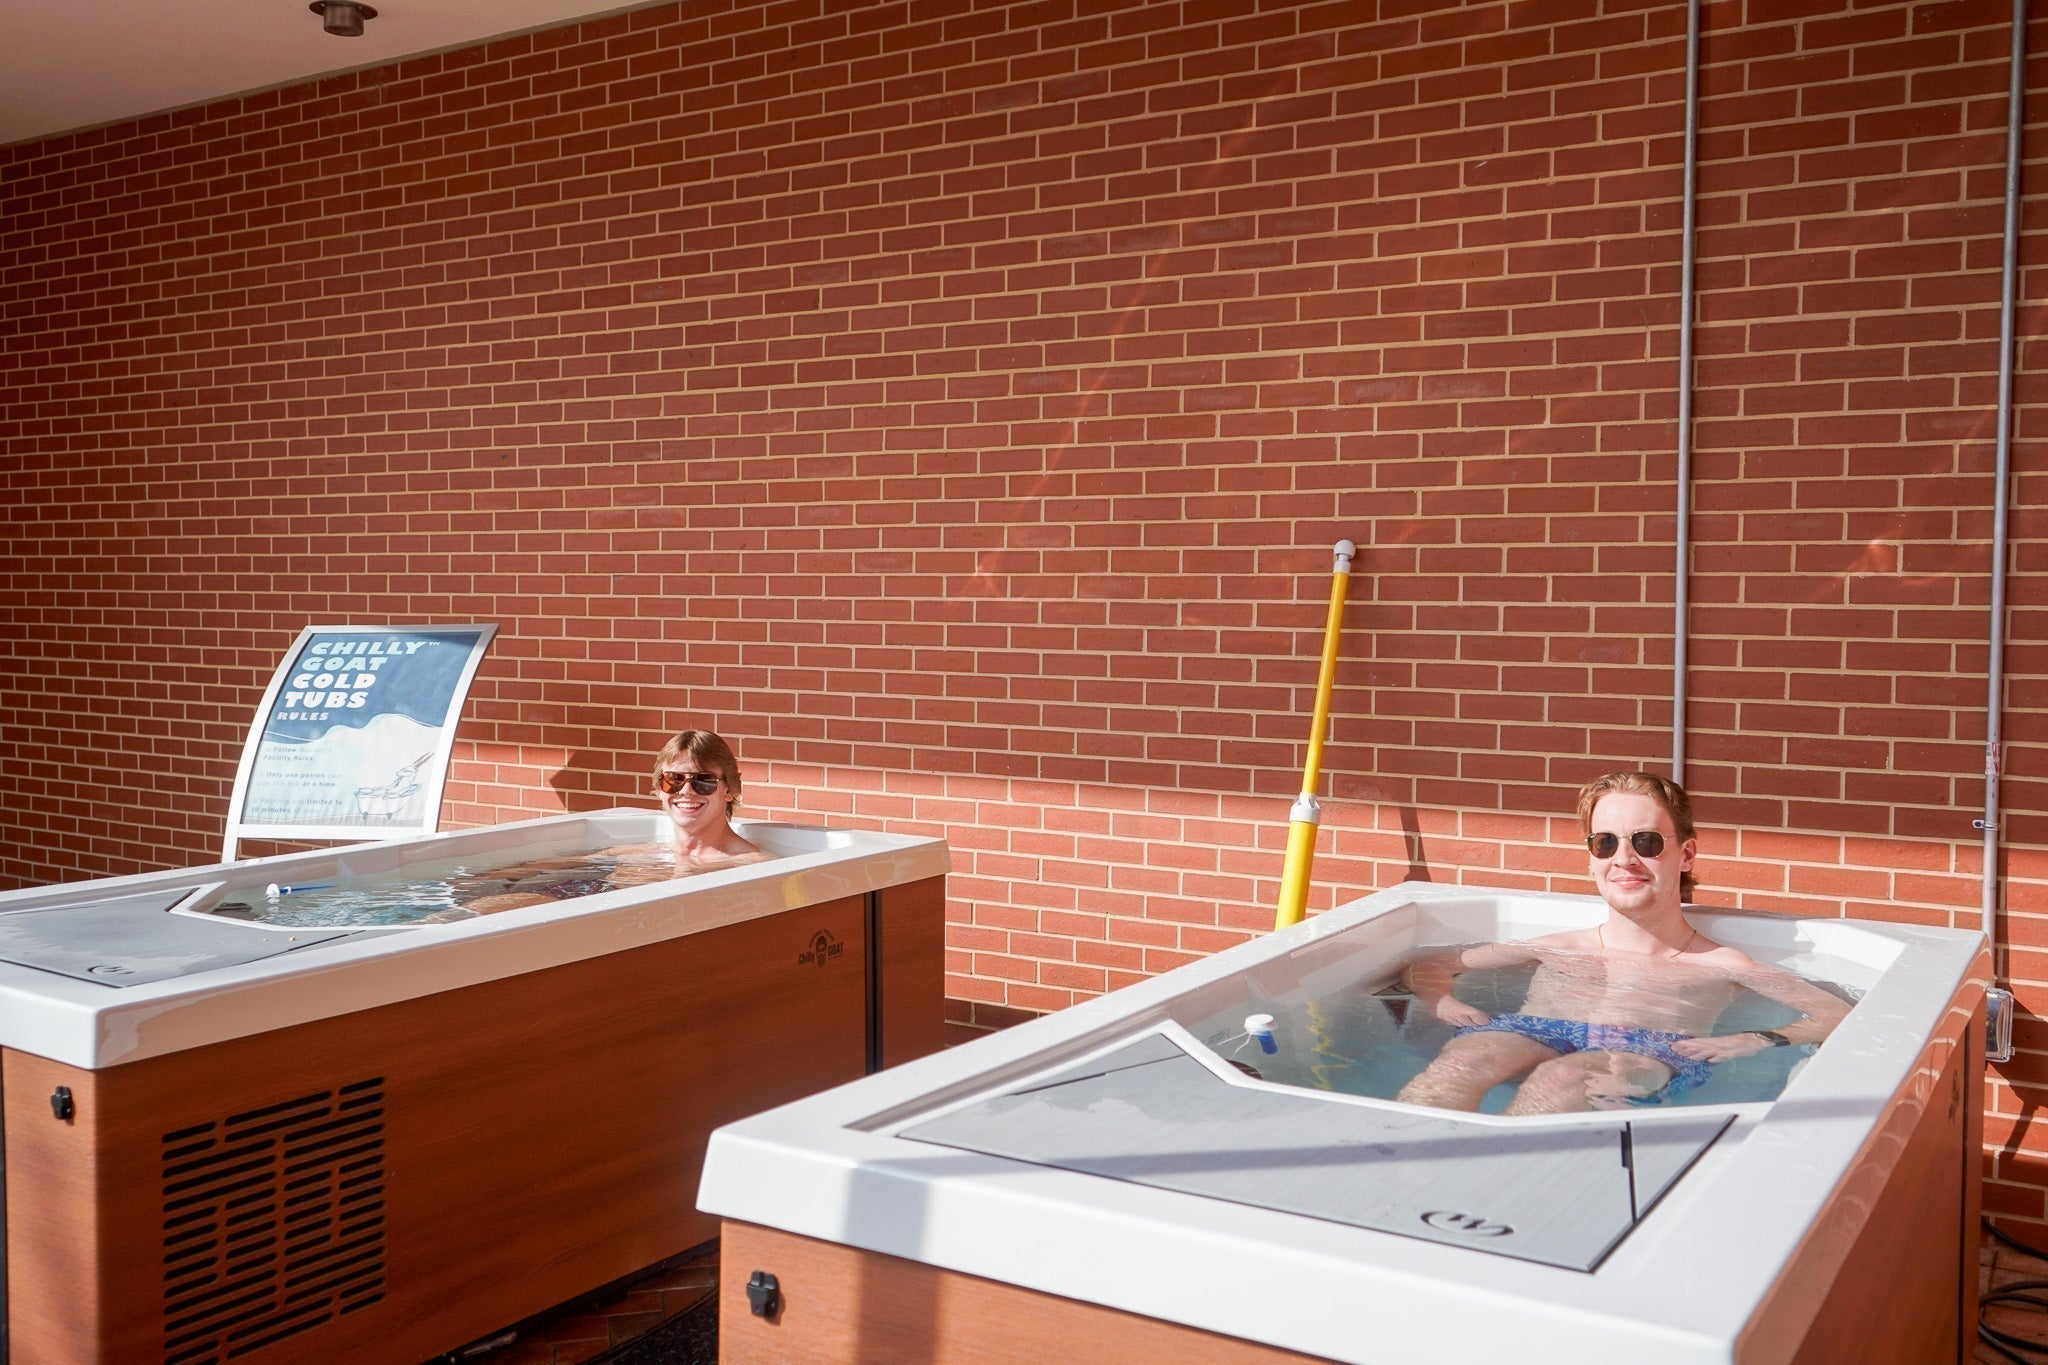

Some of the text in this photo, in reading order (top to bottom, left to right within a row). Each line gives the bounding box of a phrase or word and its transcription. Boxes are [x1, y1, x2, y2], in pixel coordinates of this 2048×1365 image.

[311, 641, 427, 655] CHILLY
[301, 657, 388, 671] GOAT
[292, 673, 377, 689] COLD
[284, 691, 369, 709] TUBS
[276, 711, 330, 721] RULES
[266, 771, 282, 779] Only
